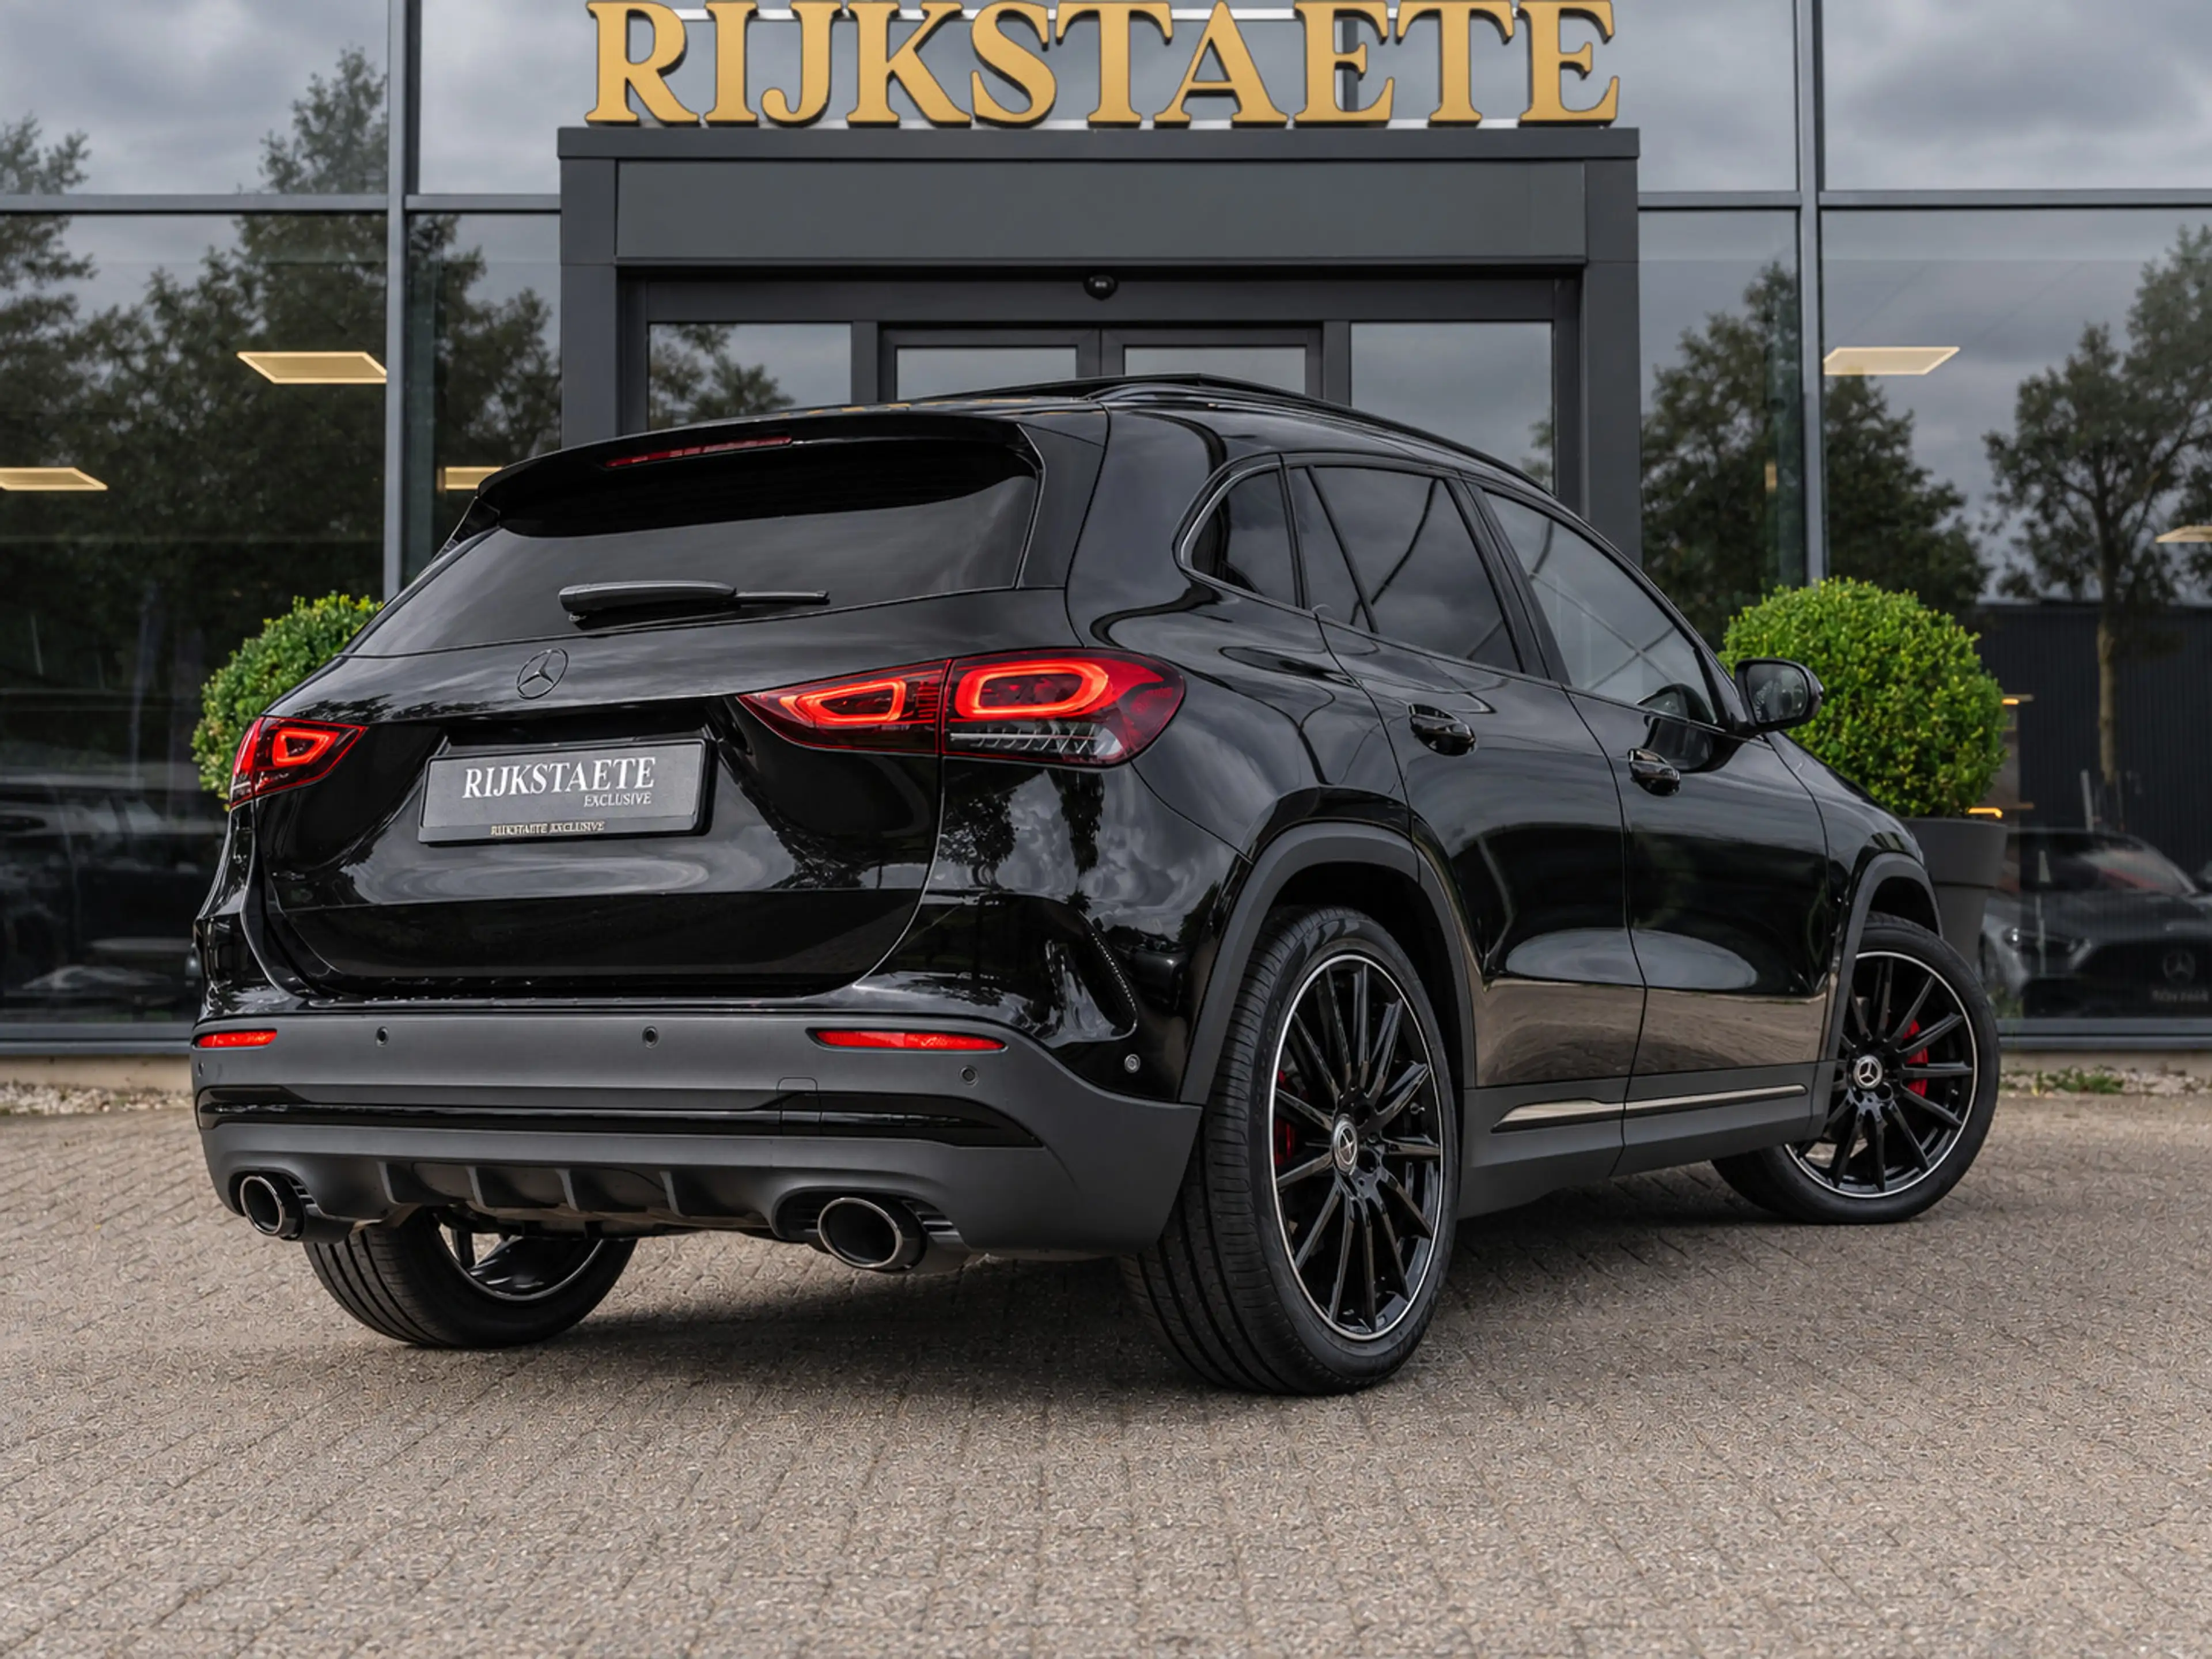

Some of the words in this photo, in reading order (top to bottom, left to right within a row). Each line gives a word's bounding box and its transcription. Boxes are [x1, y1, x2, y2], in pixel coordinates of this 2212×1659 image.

[585, 0, 1619, 128] RIJKSTAETE
[463, 757, 656, 798] RIJKSTAETE
[584, 792, 652, 807] EXCLUSIVE
